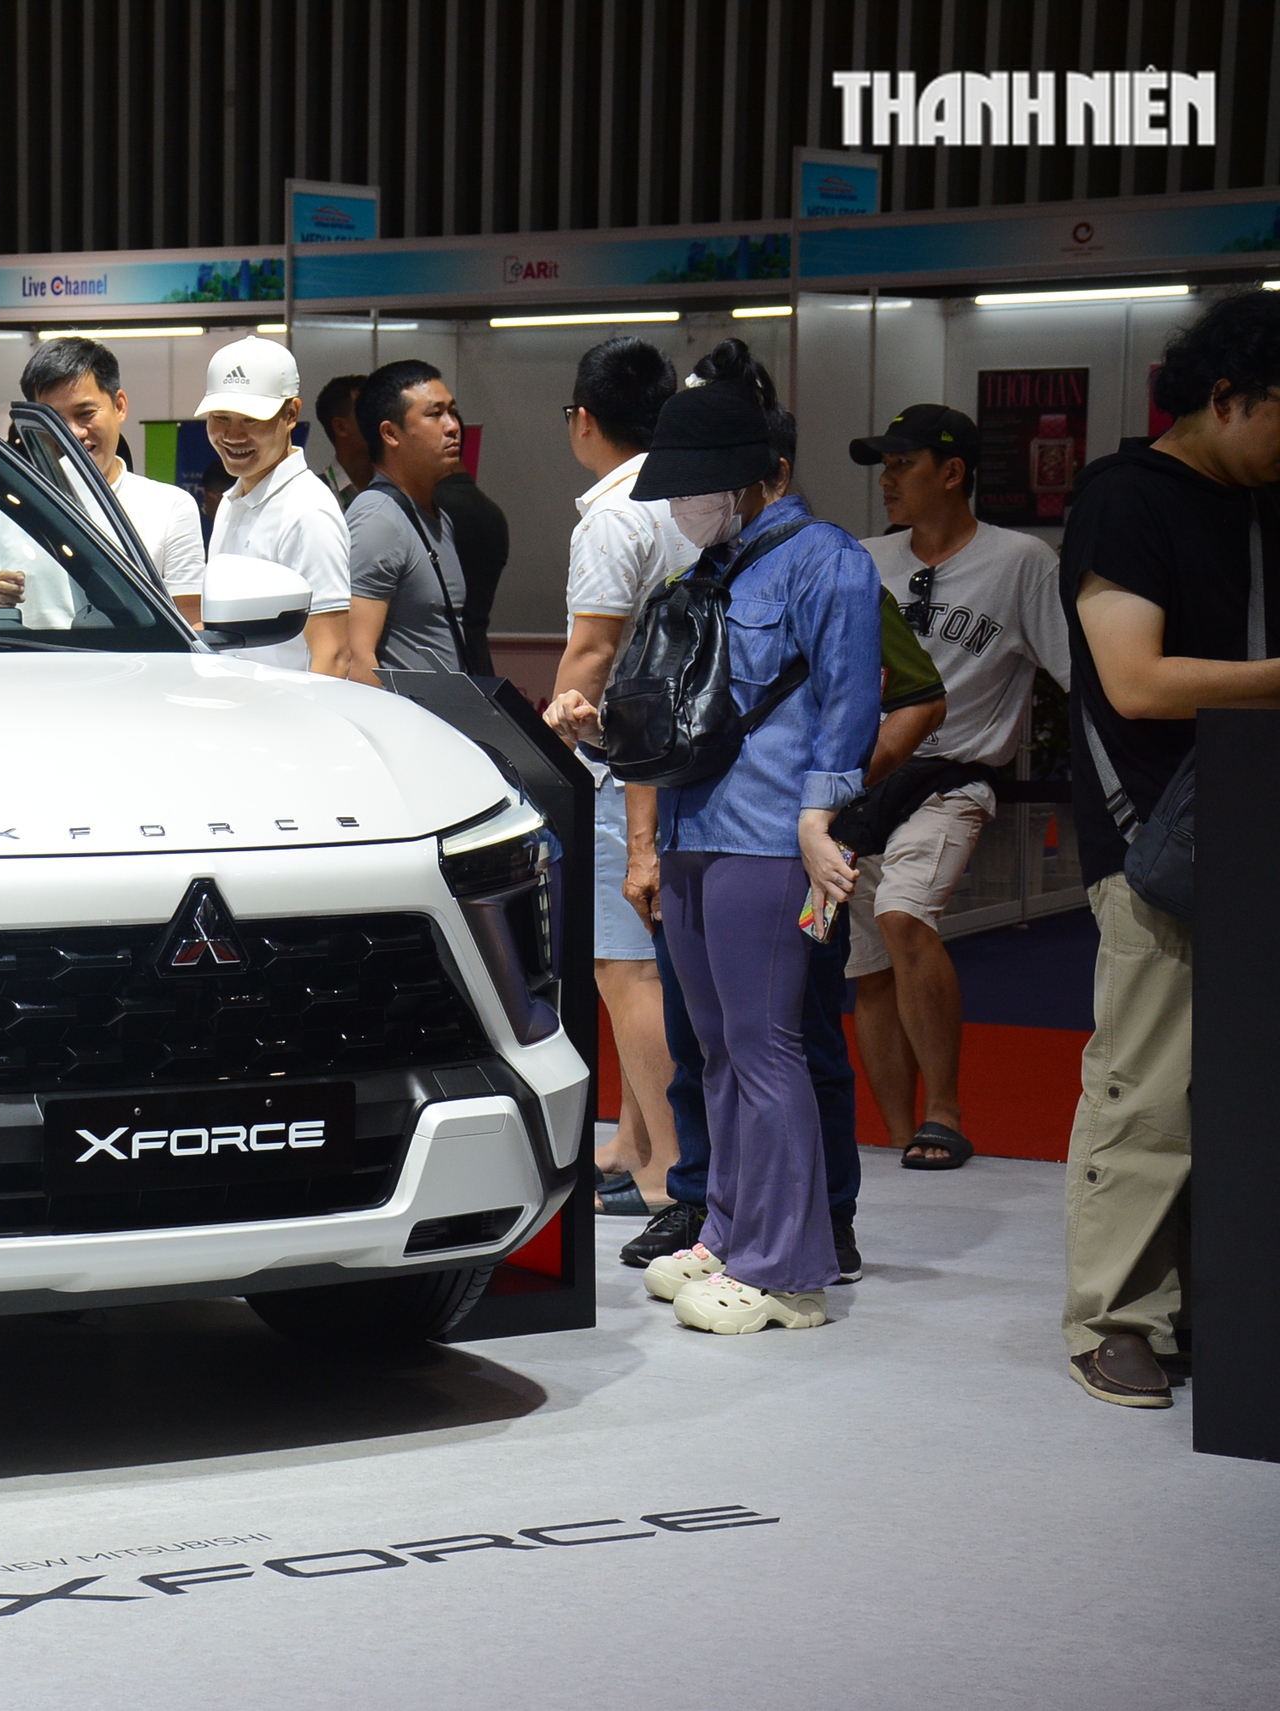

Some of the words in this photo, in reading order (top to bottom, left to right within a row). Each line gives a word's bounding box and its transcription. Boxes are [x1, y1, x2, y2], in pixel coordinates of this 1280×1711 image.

[523, 260, 559, 279] ARit
[22, 276, 47, 297] Live
[51, 274, 108, 296] Channel
[222, 376, 251, 385] adidas
[899, 602, 1004, 658] TON
[74, 1119, 327, 1163] XFORCE
[75, 1531, 274, 1565] MITSUBISHI
